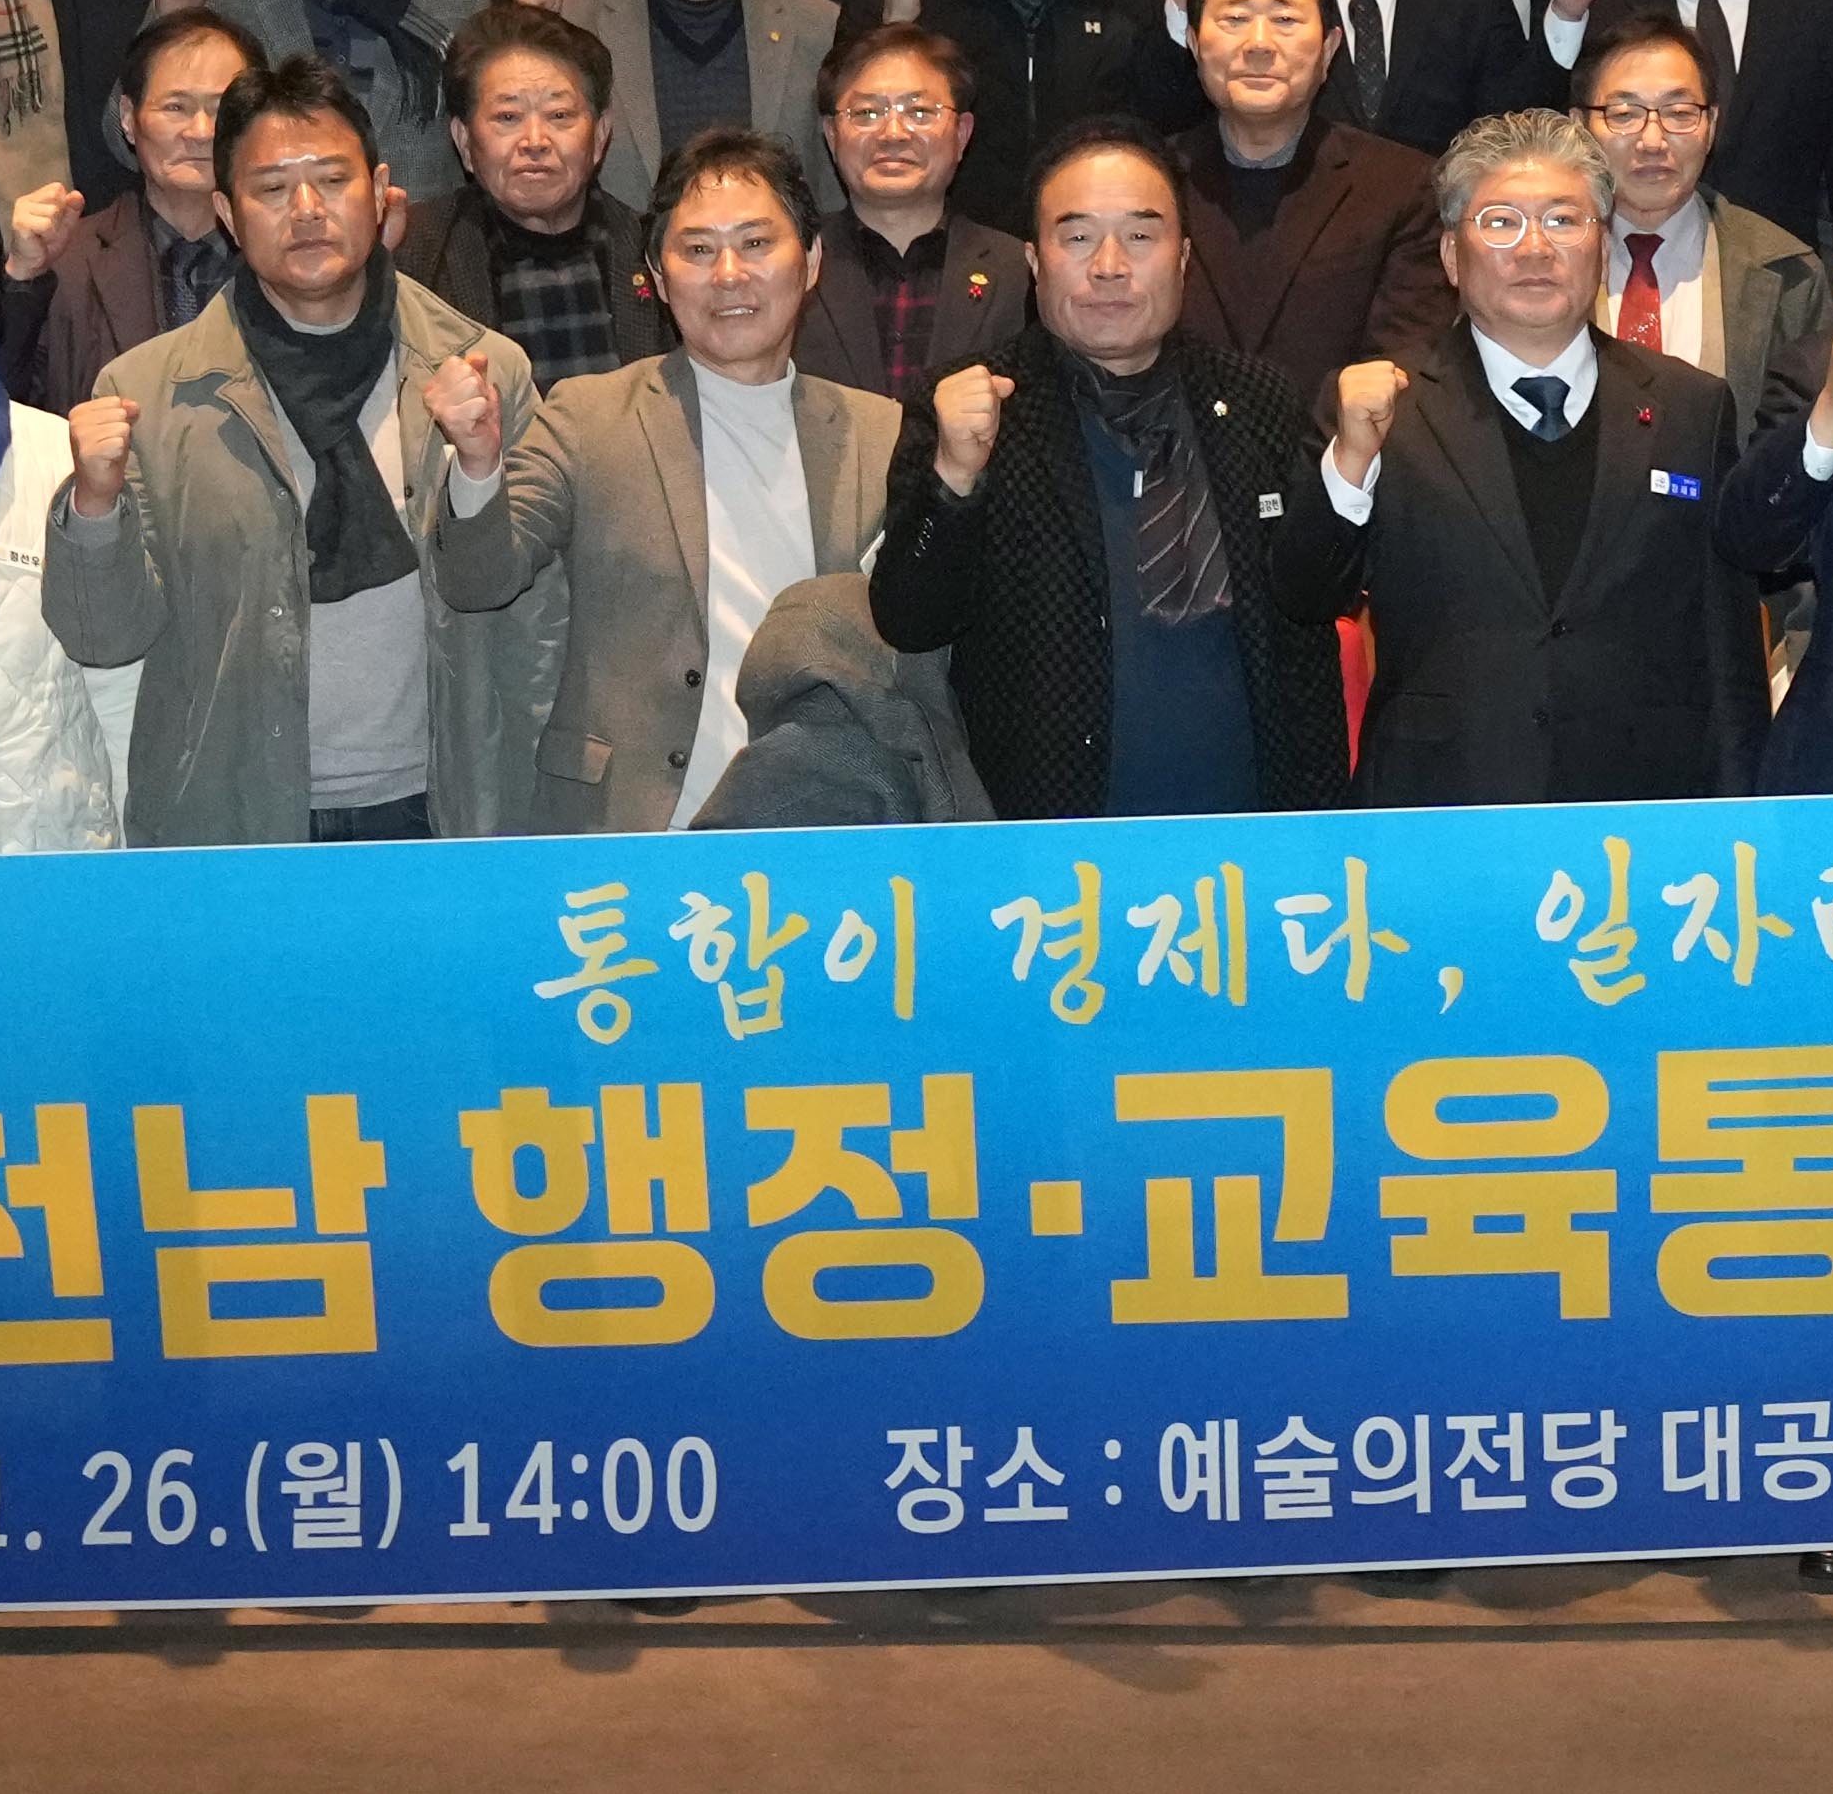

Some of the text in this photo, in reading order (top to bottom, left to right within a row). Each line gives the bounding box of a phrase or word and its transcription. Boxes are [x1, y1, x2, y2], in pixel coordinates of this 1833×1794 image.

[532, 870, 917, 1046] 통합이
[989, 855, 1465, 1026] 경제다,
[81, 1437, 403, 1553] 26.(월)
[446, 1435, 718, 1537] 14:00
[884, 1425, 1070, 1535] 장소
[1158, 1408, 1628, 1522] 예술의전당
